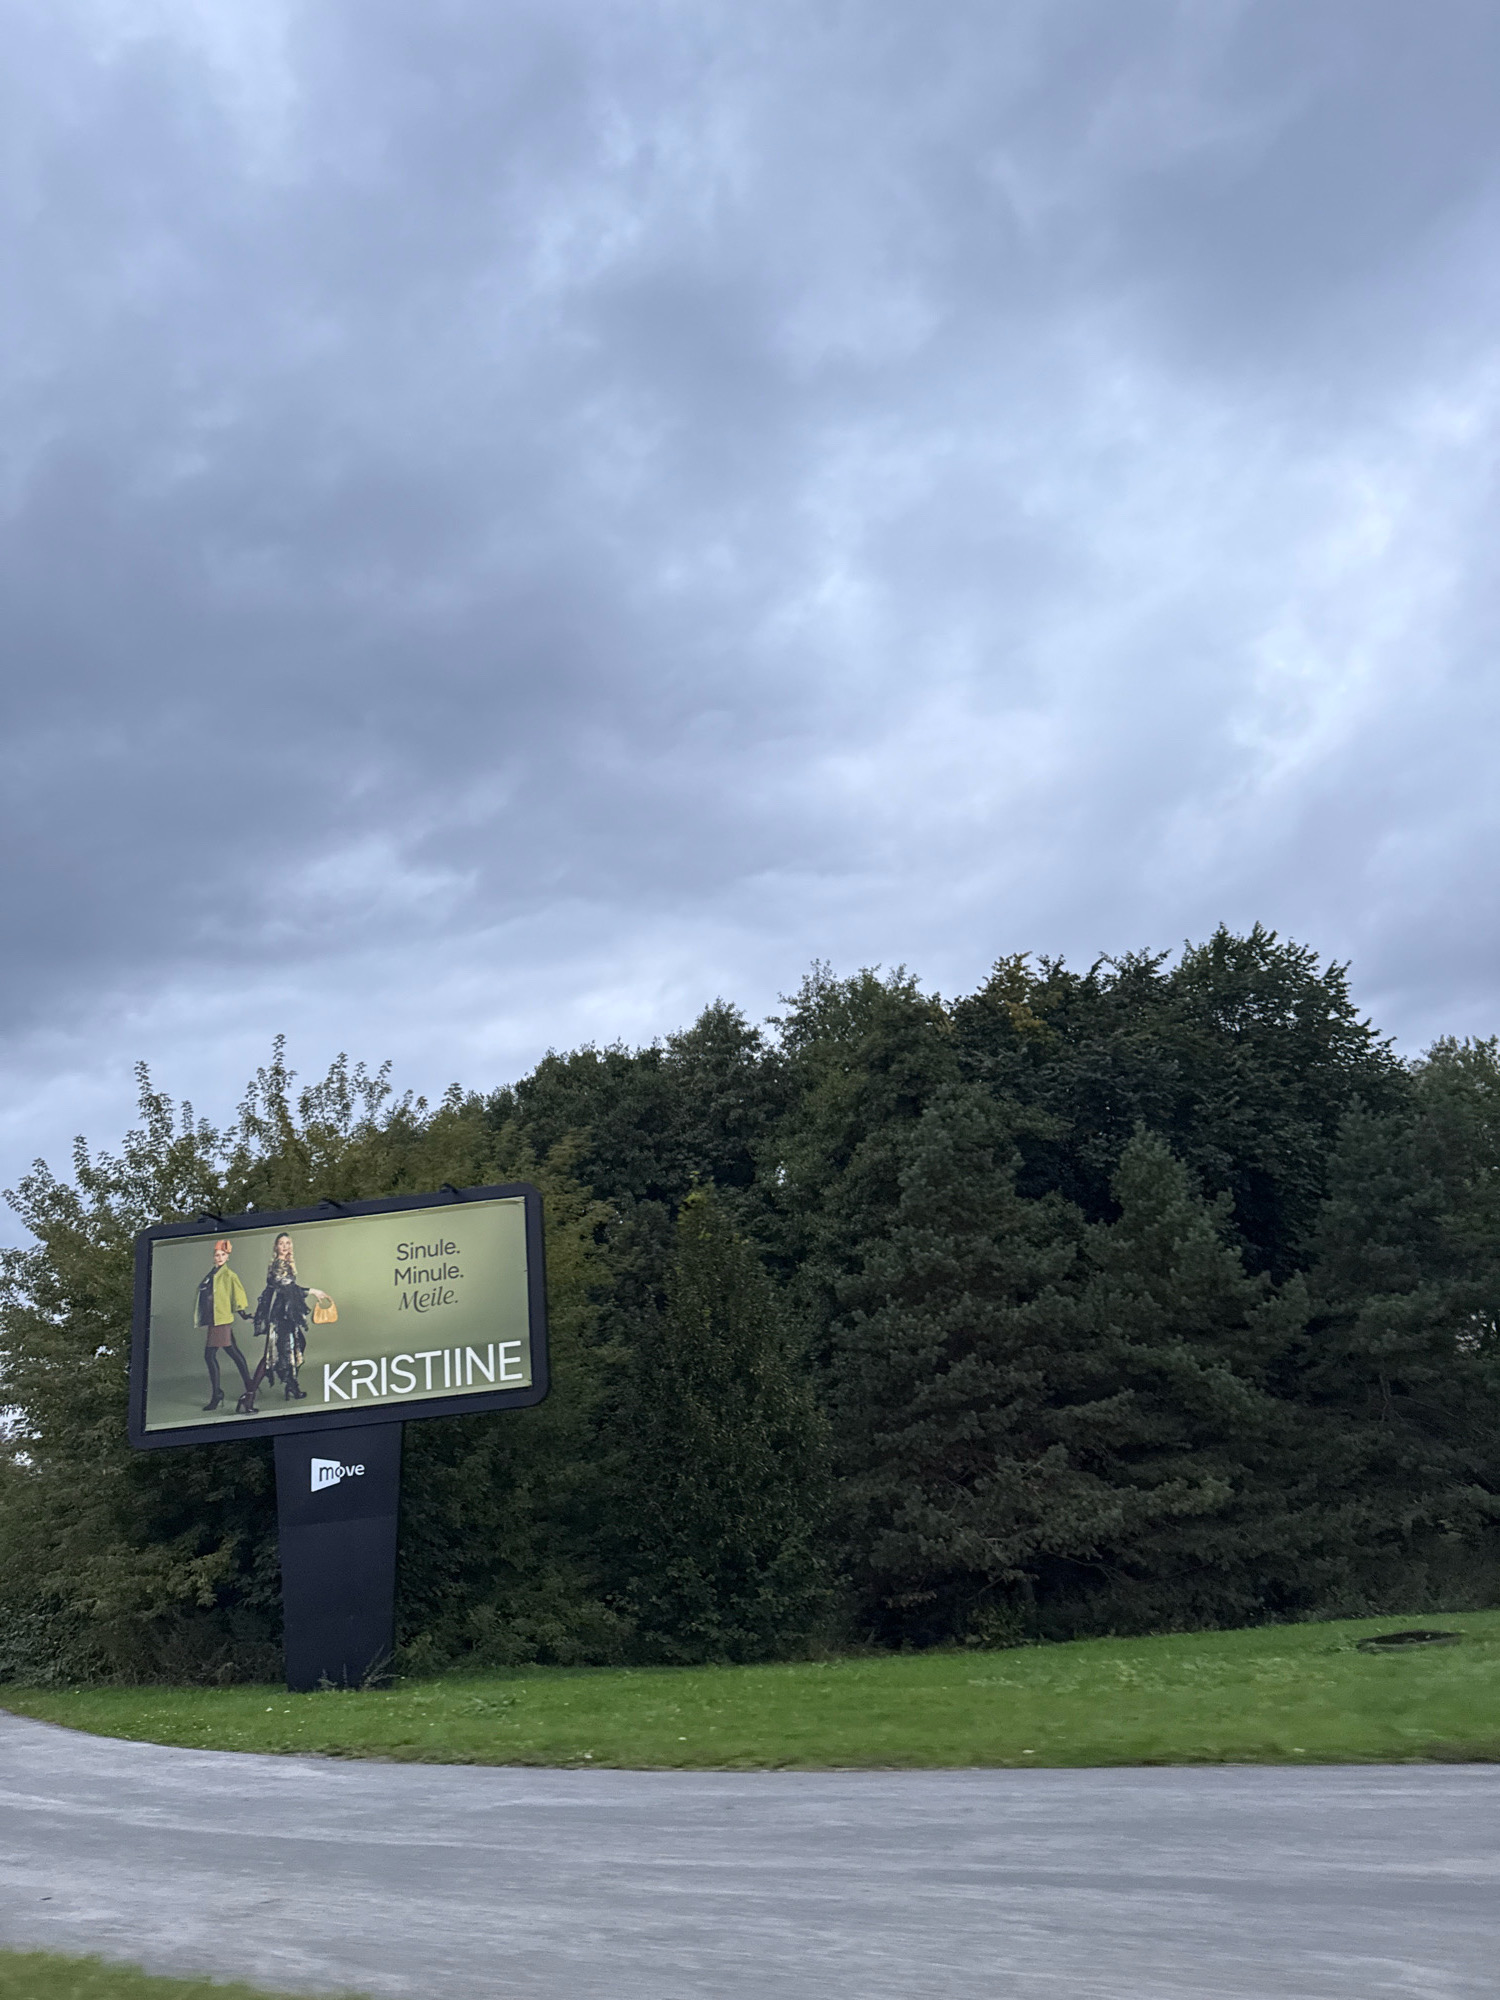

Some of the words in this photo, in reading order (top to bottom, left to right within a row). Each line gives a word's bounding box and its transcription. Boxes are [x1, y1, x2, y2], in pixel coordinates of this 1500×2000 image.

[396, 1238, 461, 1261] Sinule.
[394, 1262, 464, 1286] Minule.
[398, 1286, 459, 1313] Meile.
[323, 1340, 523, 1403] KRISTIINE
[319, 1463, 365, 1482] move
